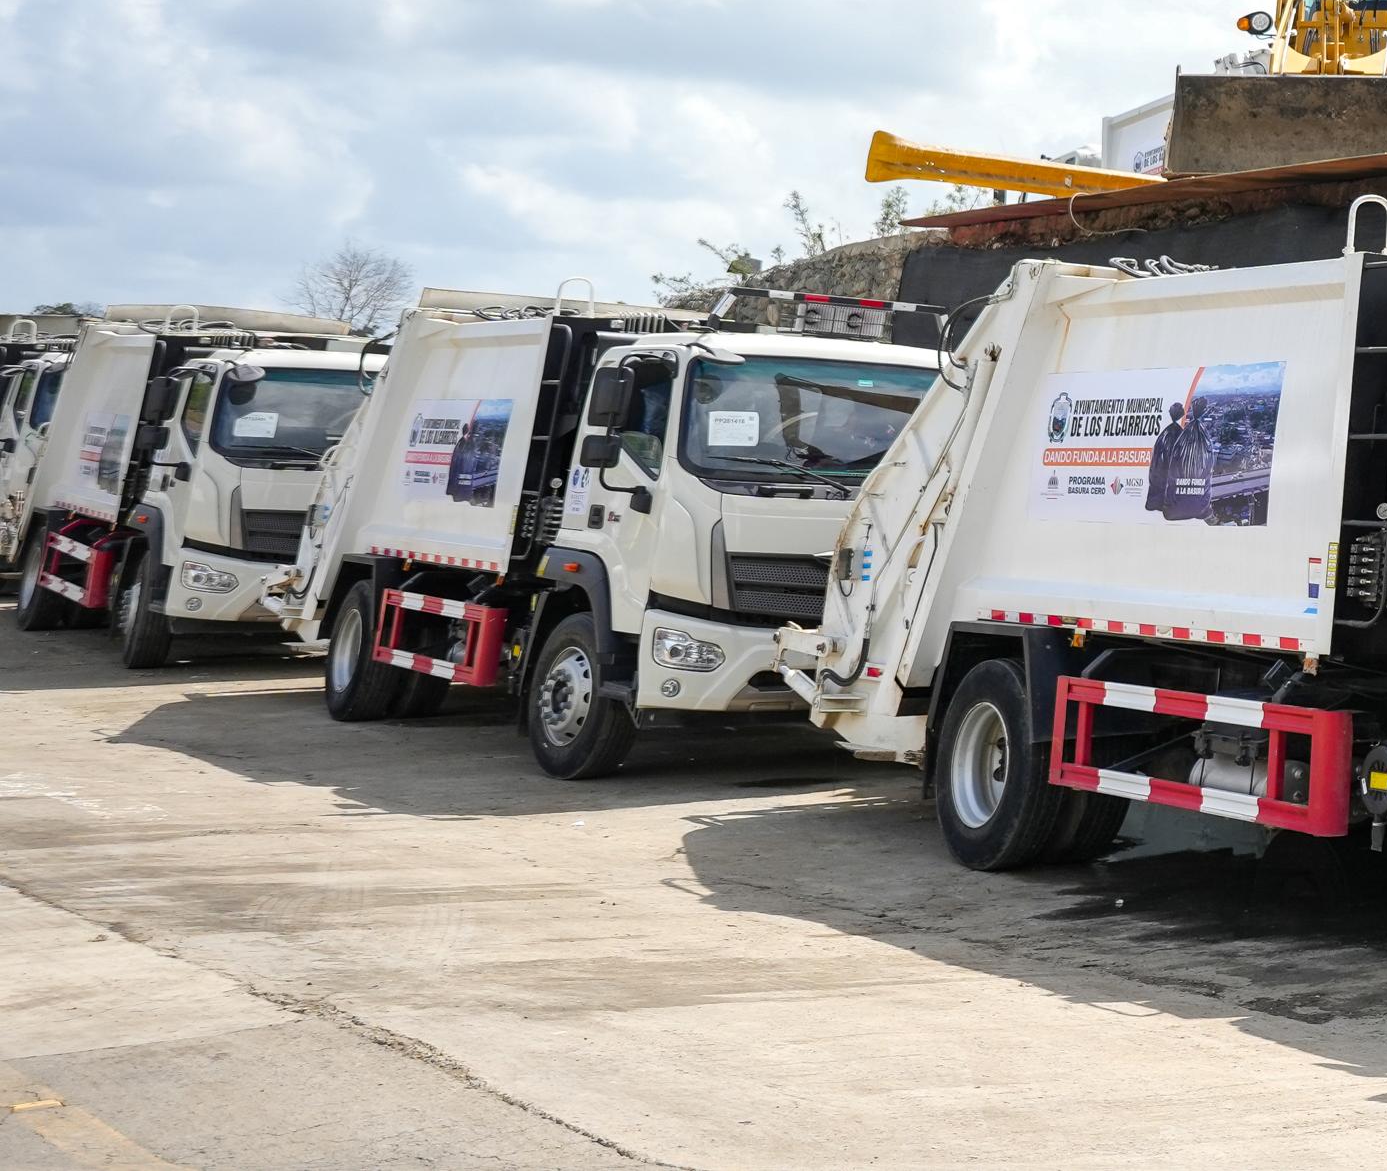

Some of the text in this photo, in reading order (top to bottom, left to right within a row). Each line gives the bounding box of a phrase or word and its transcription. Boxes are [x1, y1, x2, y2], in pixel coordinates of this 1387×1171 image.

[1073, 398, 1163, 414] AYUNTAMIENTO MUNICIPAL
[1070, 415, 1162, 437] DE LOS ALCARRIZOS
[1044, 450, 1151, 463] DANDO FUNDA A LA BASURA
[1068, 476, 1105, 485] PROGRAMA
[1067, 486, 1089, 494] BASURA
[1091, 487, 1106, 495] CERO
